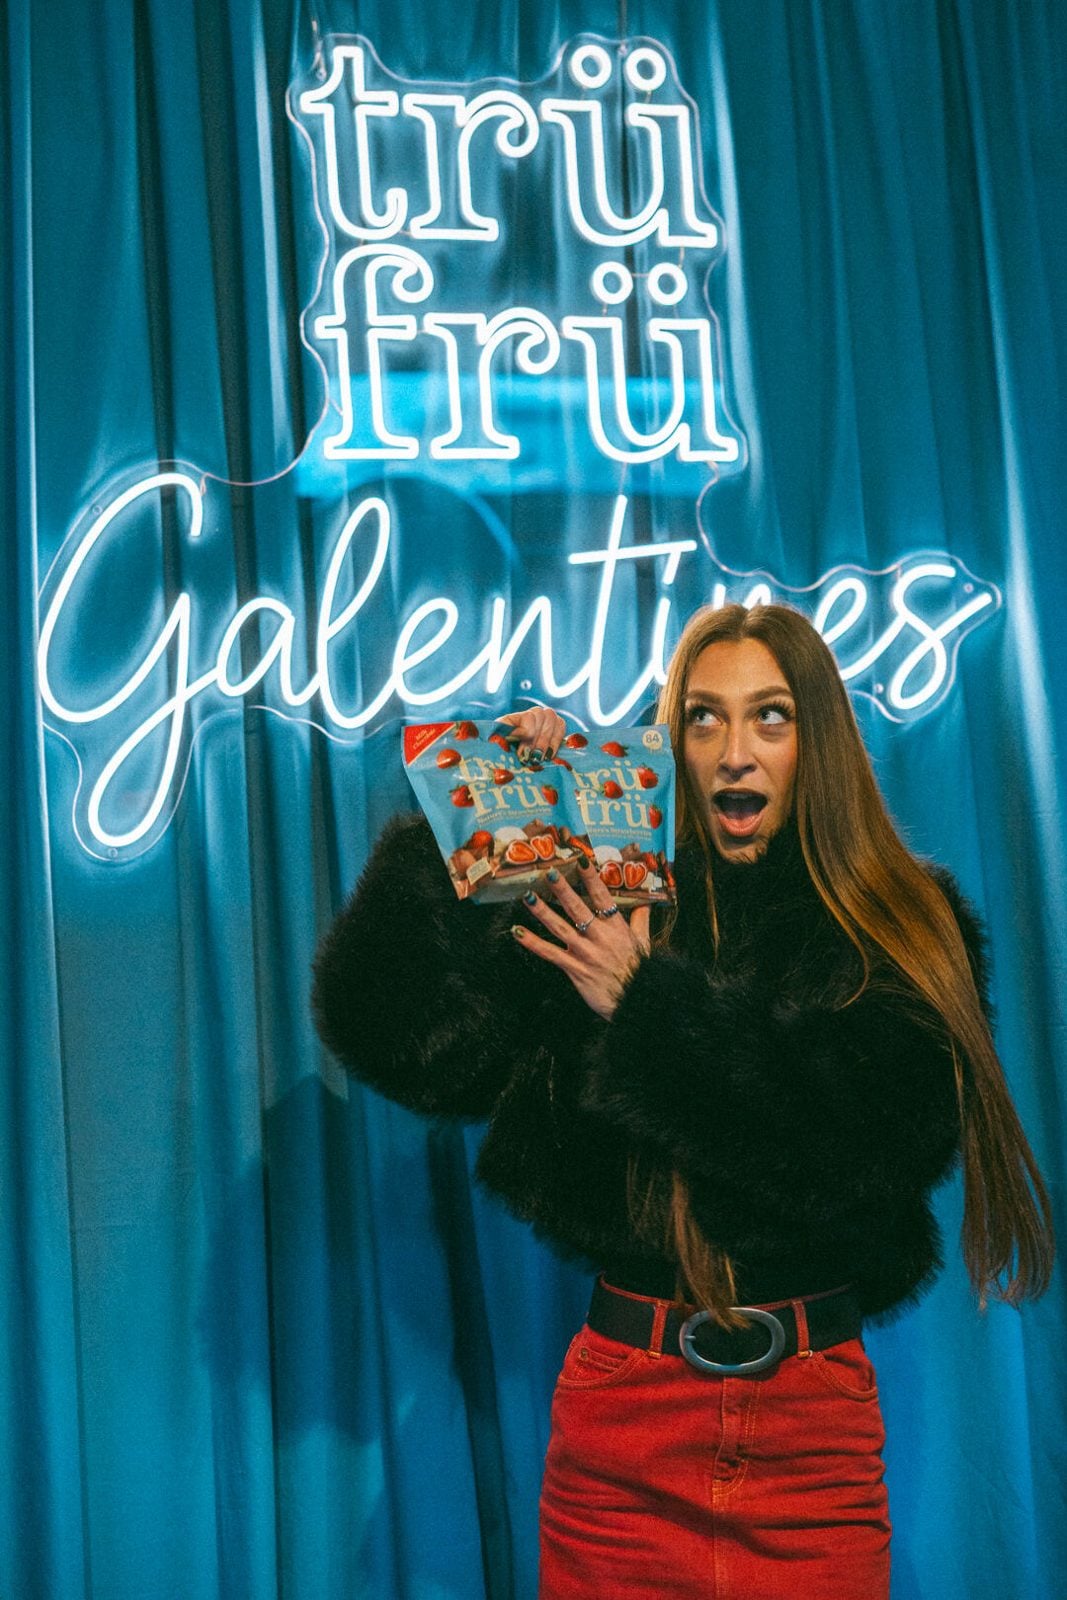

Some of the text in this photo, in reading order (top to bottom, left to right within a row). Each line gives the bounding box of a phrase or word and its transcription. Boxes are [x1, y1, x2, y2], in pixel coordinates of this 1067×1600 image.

[300, 45, 717, 247] trü
[314, 243, 738, 464] frü
[37, 472, 992, 847] Galenties
[468, 776, 550, 818] frü
[577, 789, 651, 829] frü
